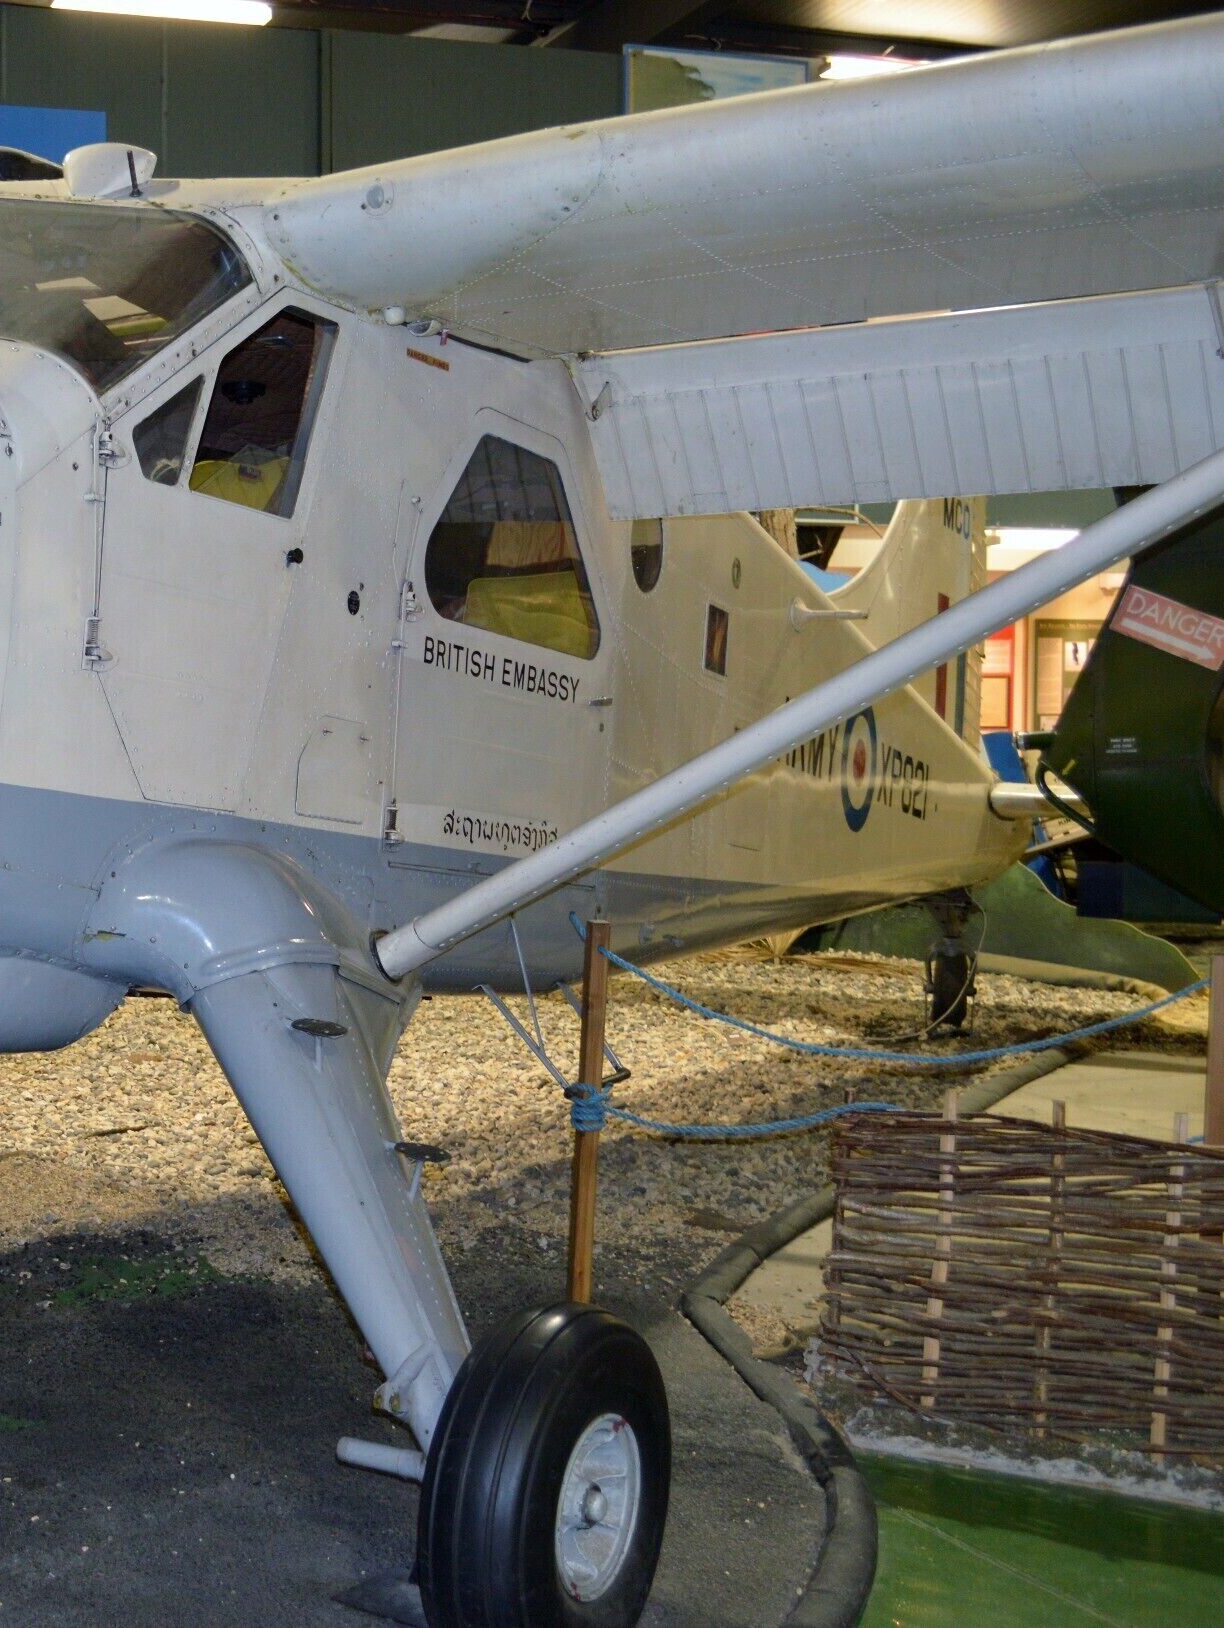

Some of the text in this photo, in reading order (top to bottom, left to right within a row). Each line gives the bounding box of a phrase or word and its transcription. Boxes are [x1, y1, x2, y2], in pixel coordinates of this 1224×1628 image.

[1126, 593, 1224, 648] DANGER
[423, 635, 580, 703] BRITISH EMBASSY
